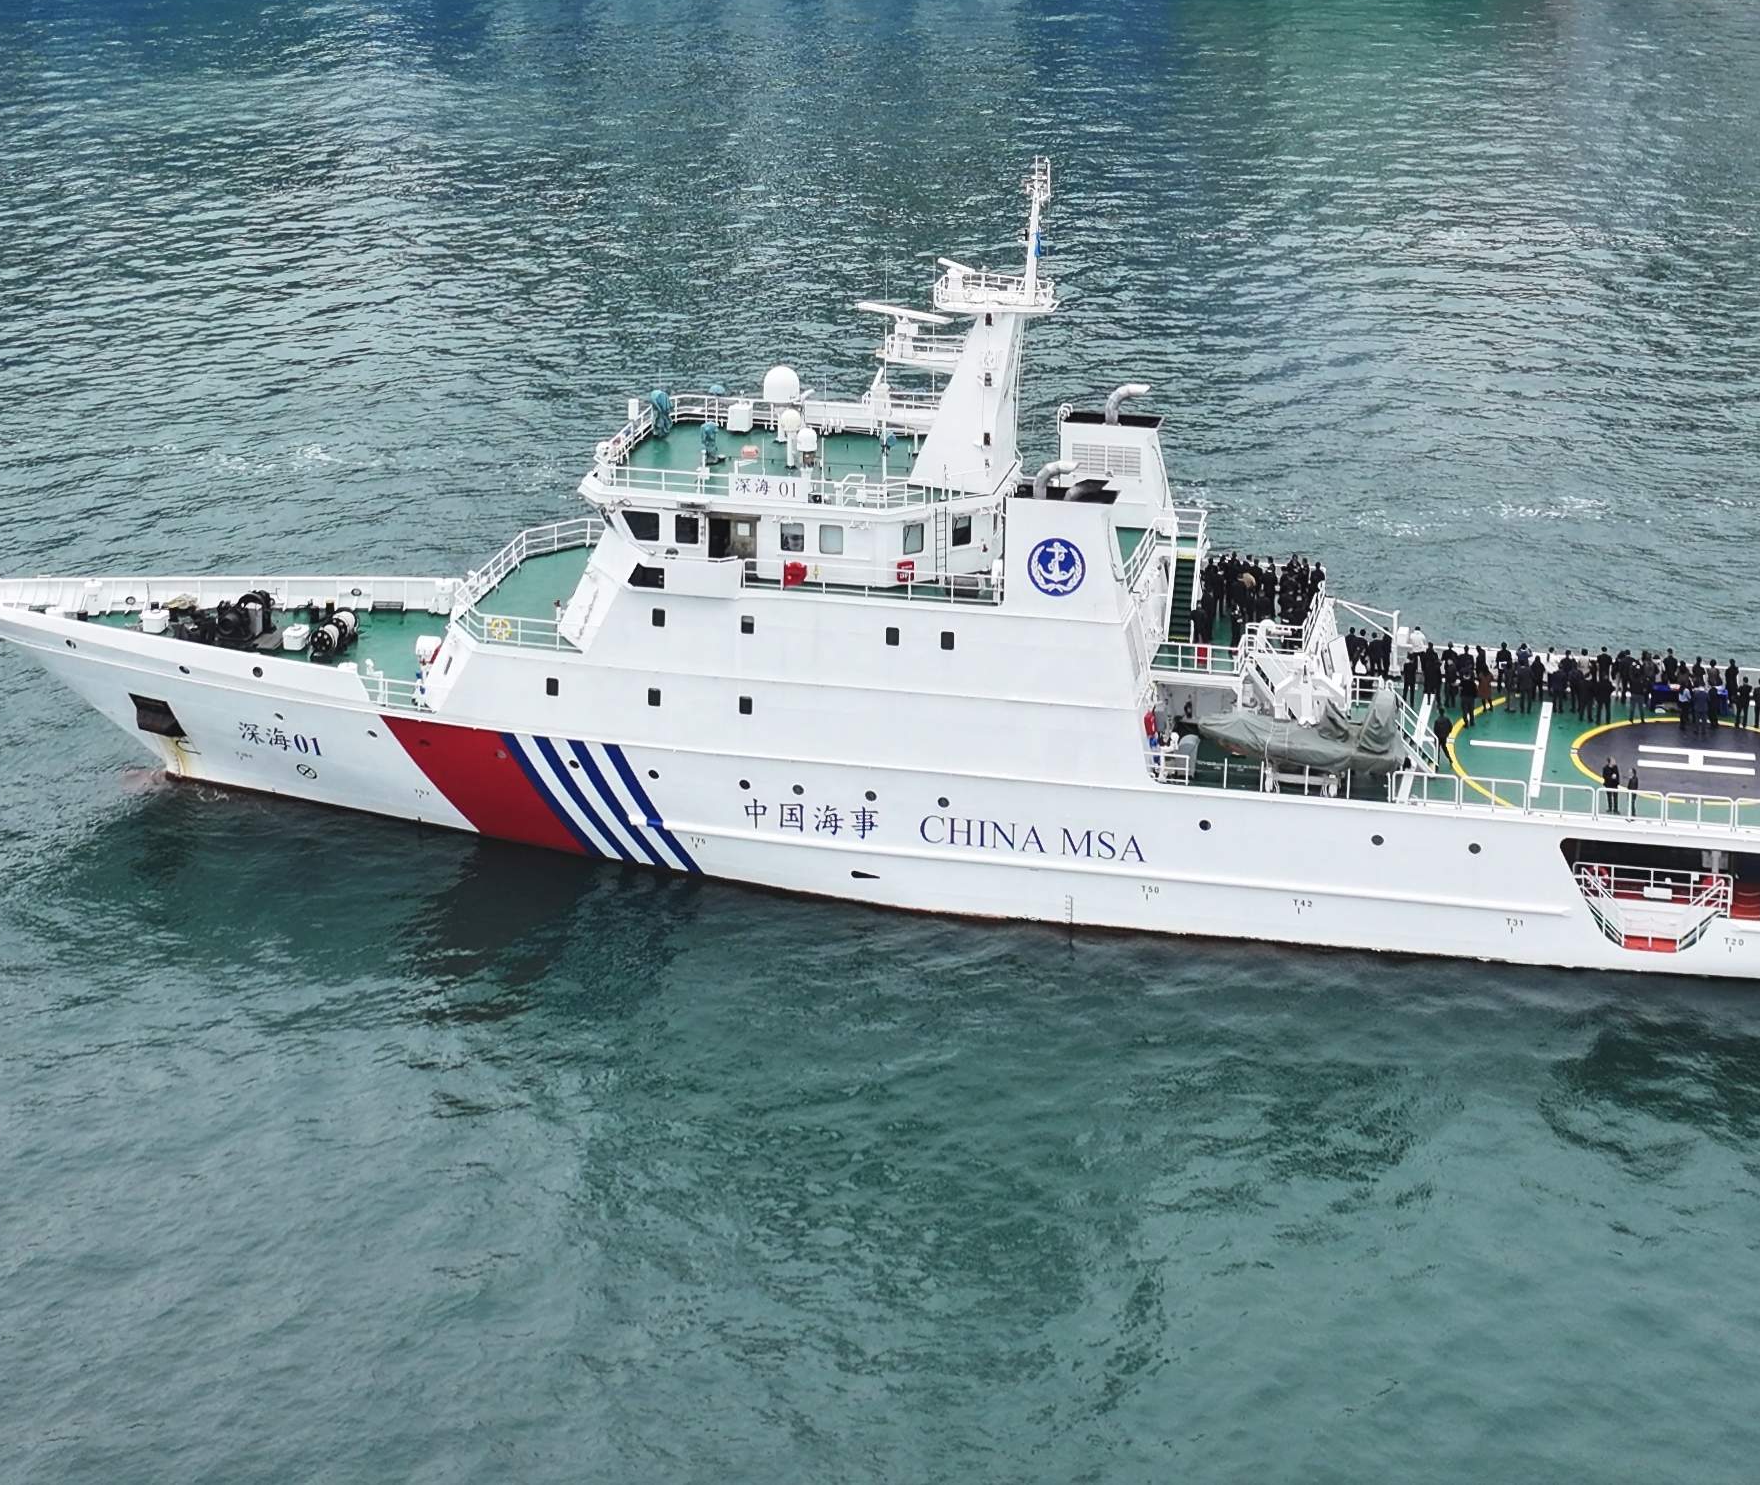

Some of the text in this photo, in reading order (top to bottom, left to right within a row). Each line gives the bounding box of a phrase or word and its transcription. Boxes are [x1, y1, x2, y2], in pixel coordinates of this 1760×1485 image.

[735, 478, 796, 498] 深海 01
[238, 721, 323, 757] 深海01
[743, 798, 880, 839] 中国海事
[919, 814, 1148, 863] CHINA MSA
[1141, 885, 1160, 894] T50
[1293, 898, 1313, 908] T42
[1506, 917, 1524, 927] T31
[1724, 937, 1744, 946] T20
